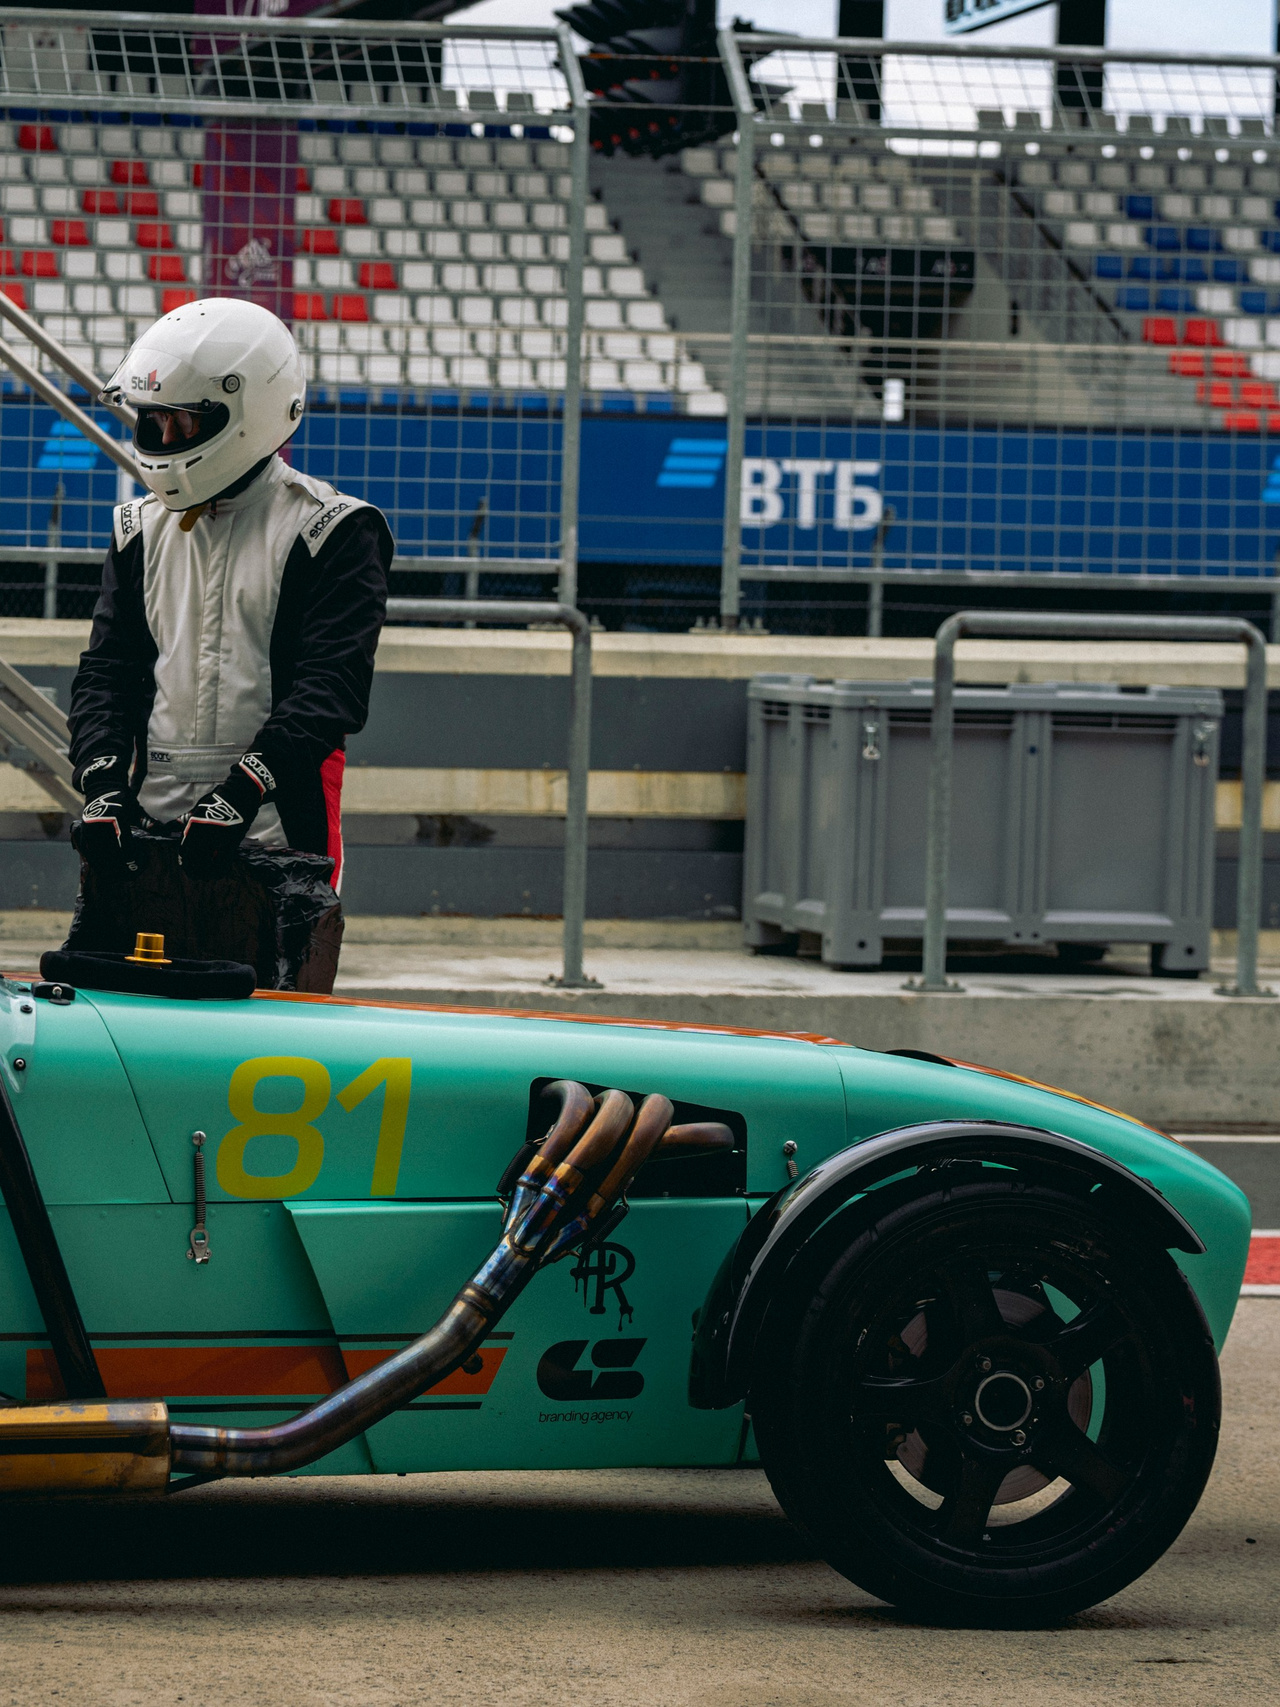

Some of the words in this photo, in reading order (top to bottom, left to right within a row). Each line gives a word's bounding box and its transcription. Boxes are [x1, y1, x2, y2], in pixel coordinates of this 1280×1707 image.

[131, 369, 162, 392] Stilo
[740, 458, 884, 531] ВТБ
[309, 503, 350, 540] sparco
[216, 1056, 413, 1199] 81
[538, 1411, 590, 1424] branding
[590, 1410, 633, 1423] agency
